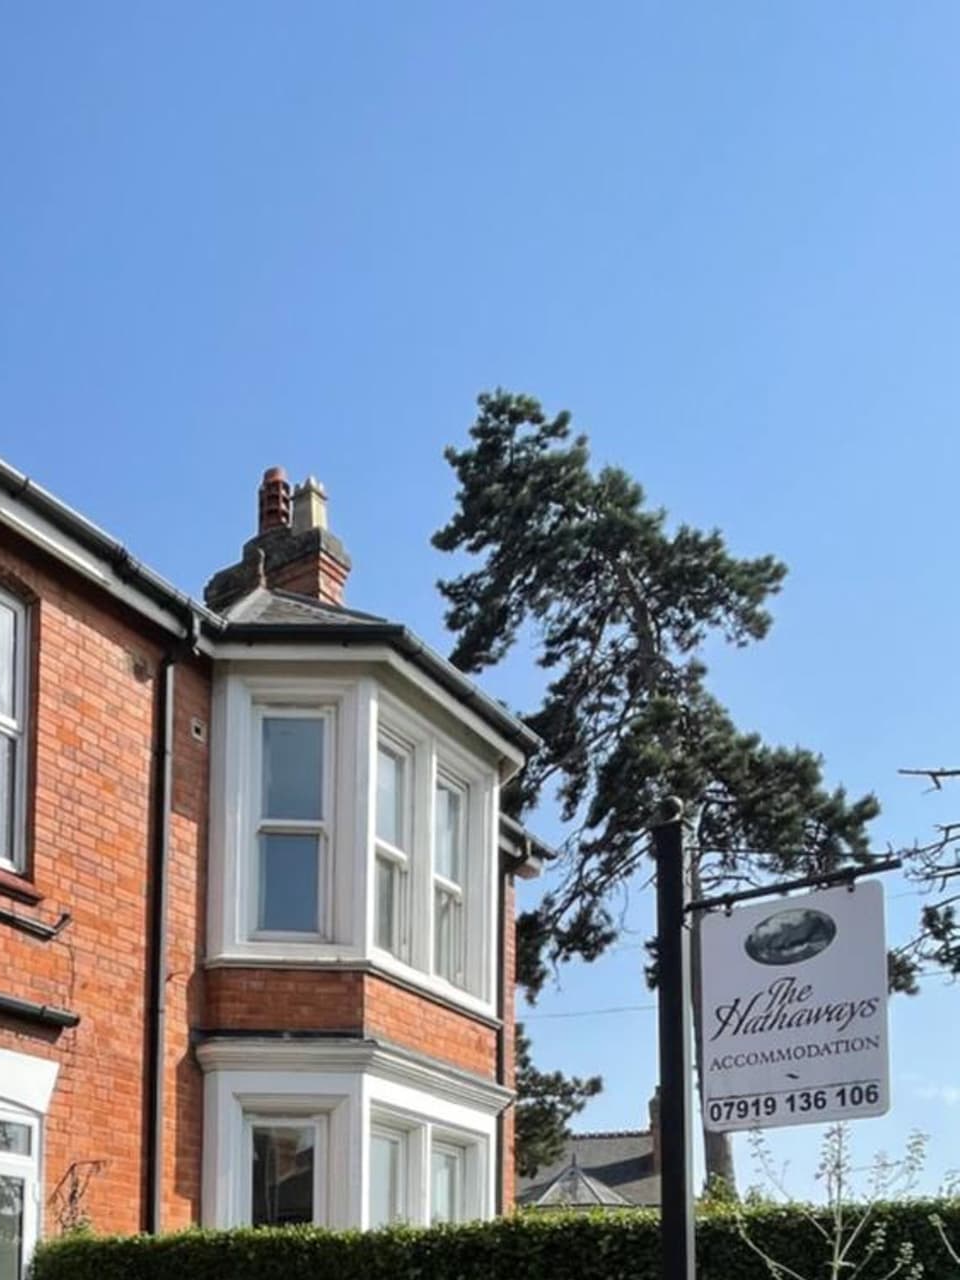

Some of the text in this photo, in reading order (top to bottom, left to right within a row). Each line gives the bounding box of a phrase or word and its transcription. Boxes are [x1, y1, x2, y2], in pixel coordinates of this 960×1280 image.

[766, 976, 813, 1010] The
[709, 991, 880, 1042] Hathaways
[709, 1035, 880, 1072] ACCOMMODATION
[709, 1084, 879, 1122] 07919 136 106
